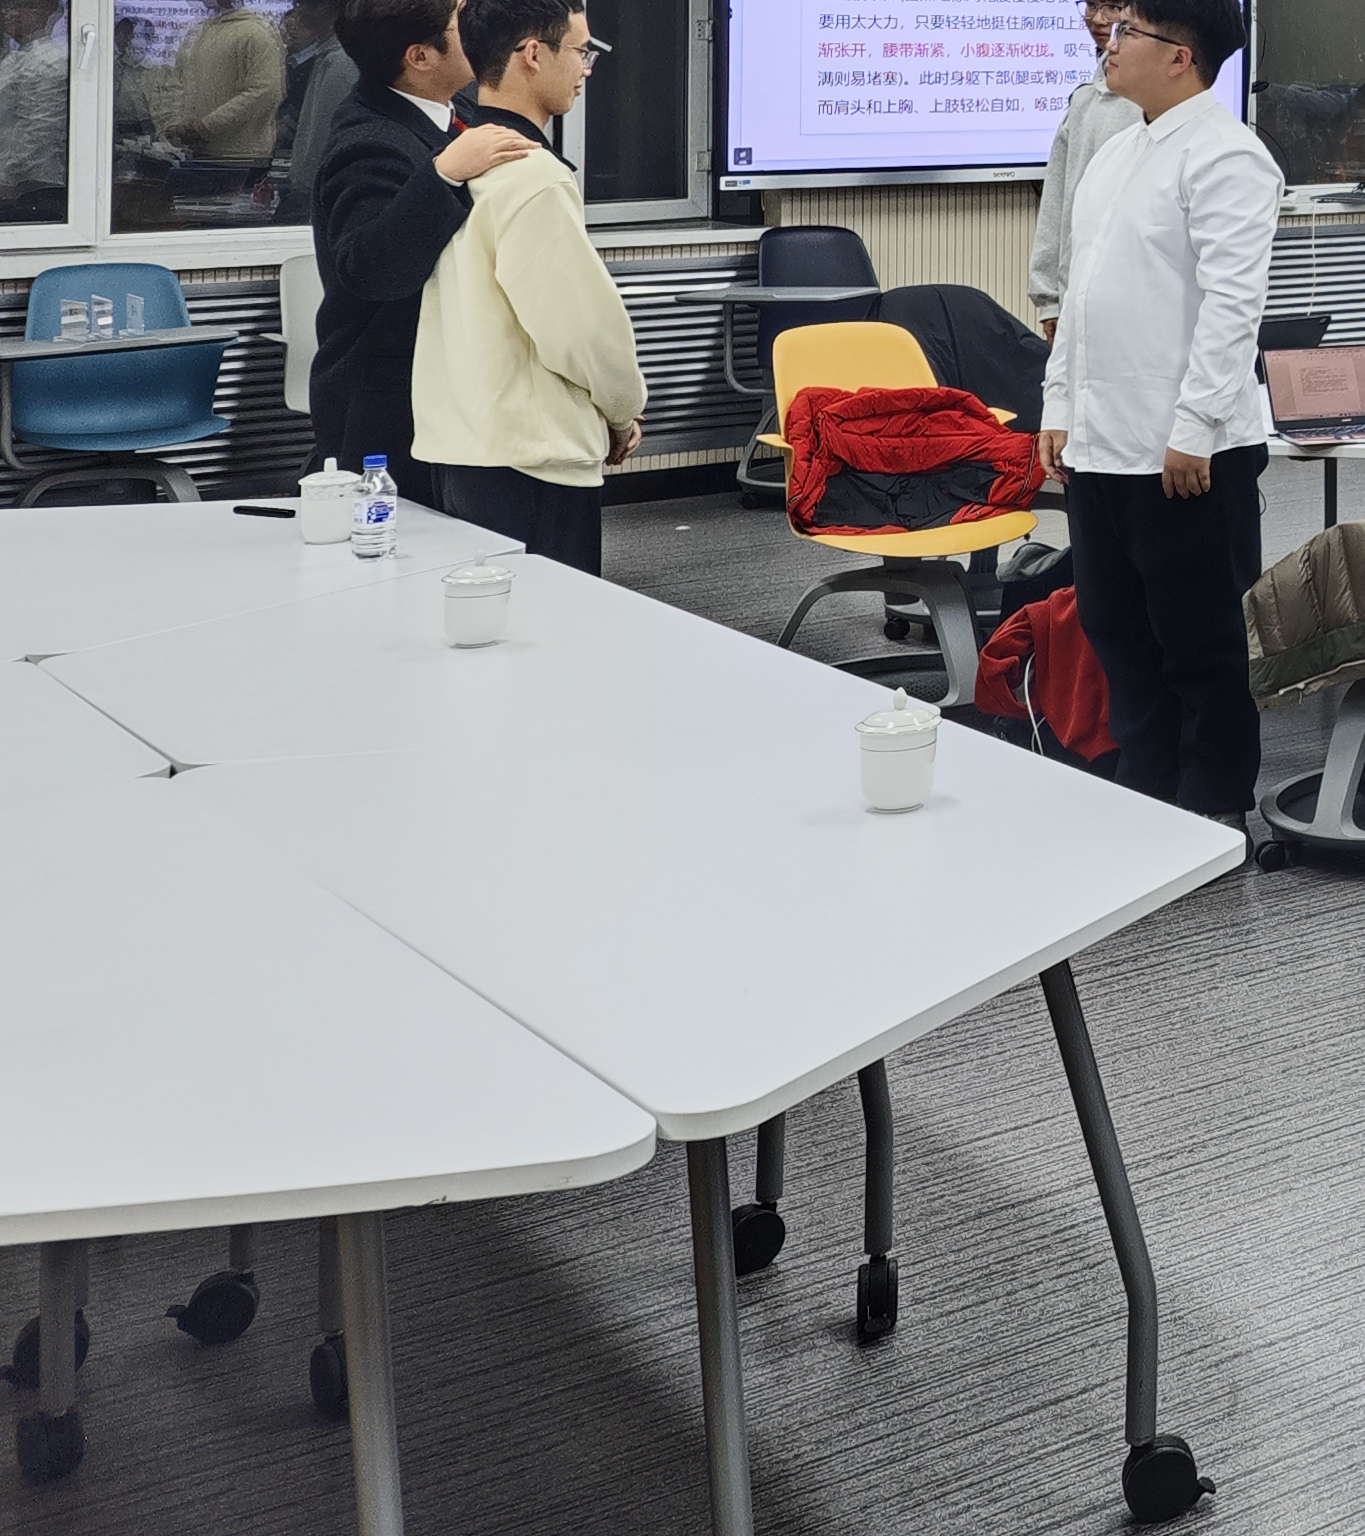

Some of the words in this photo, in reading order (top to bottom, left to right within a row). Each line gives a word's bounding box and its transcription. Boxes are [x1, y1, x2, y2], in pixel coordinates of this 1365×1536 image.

[817, 42, 1096, 59] 渐张开，腰带渐紧，小腹逐渐收拢。吸气
